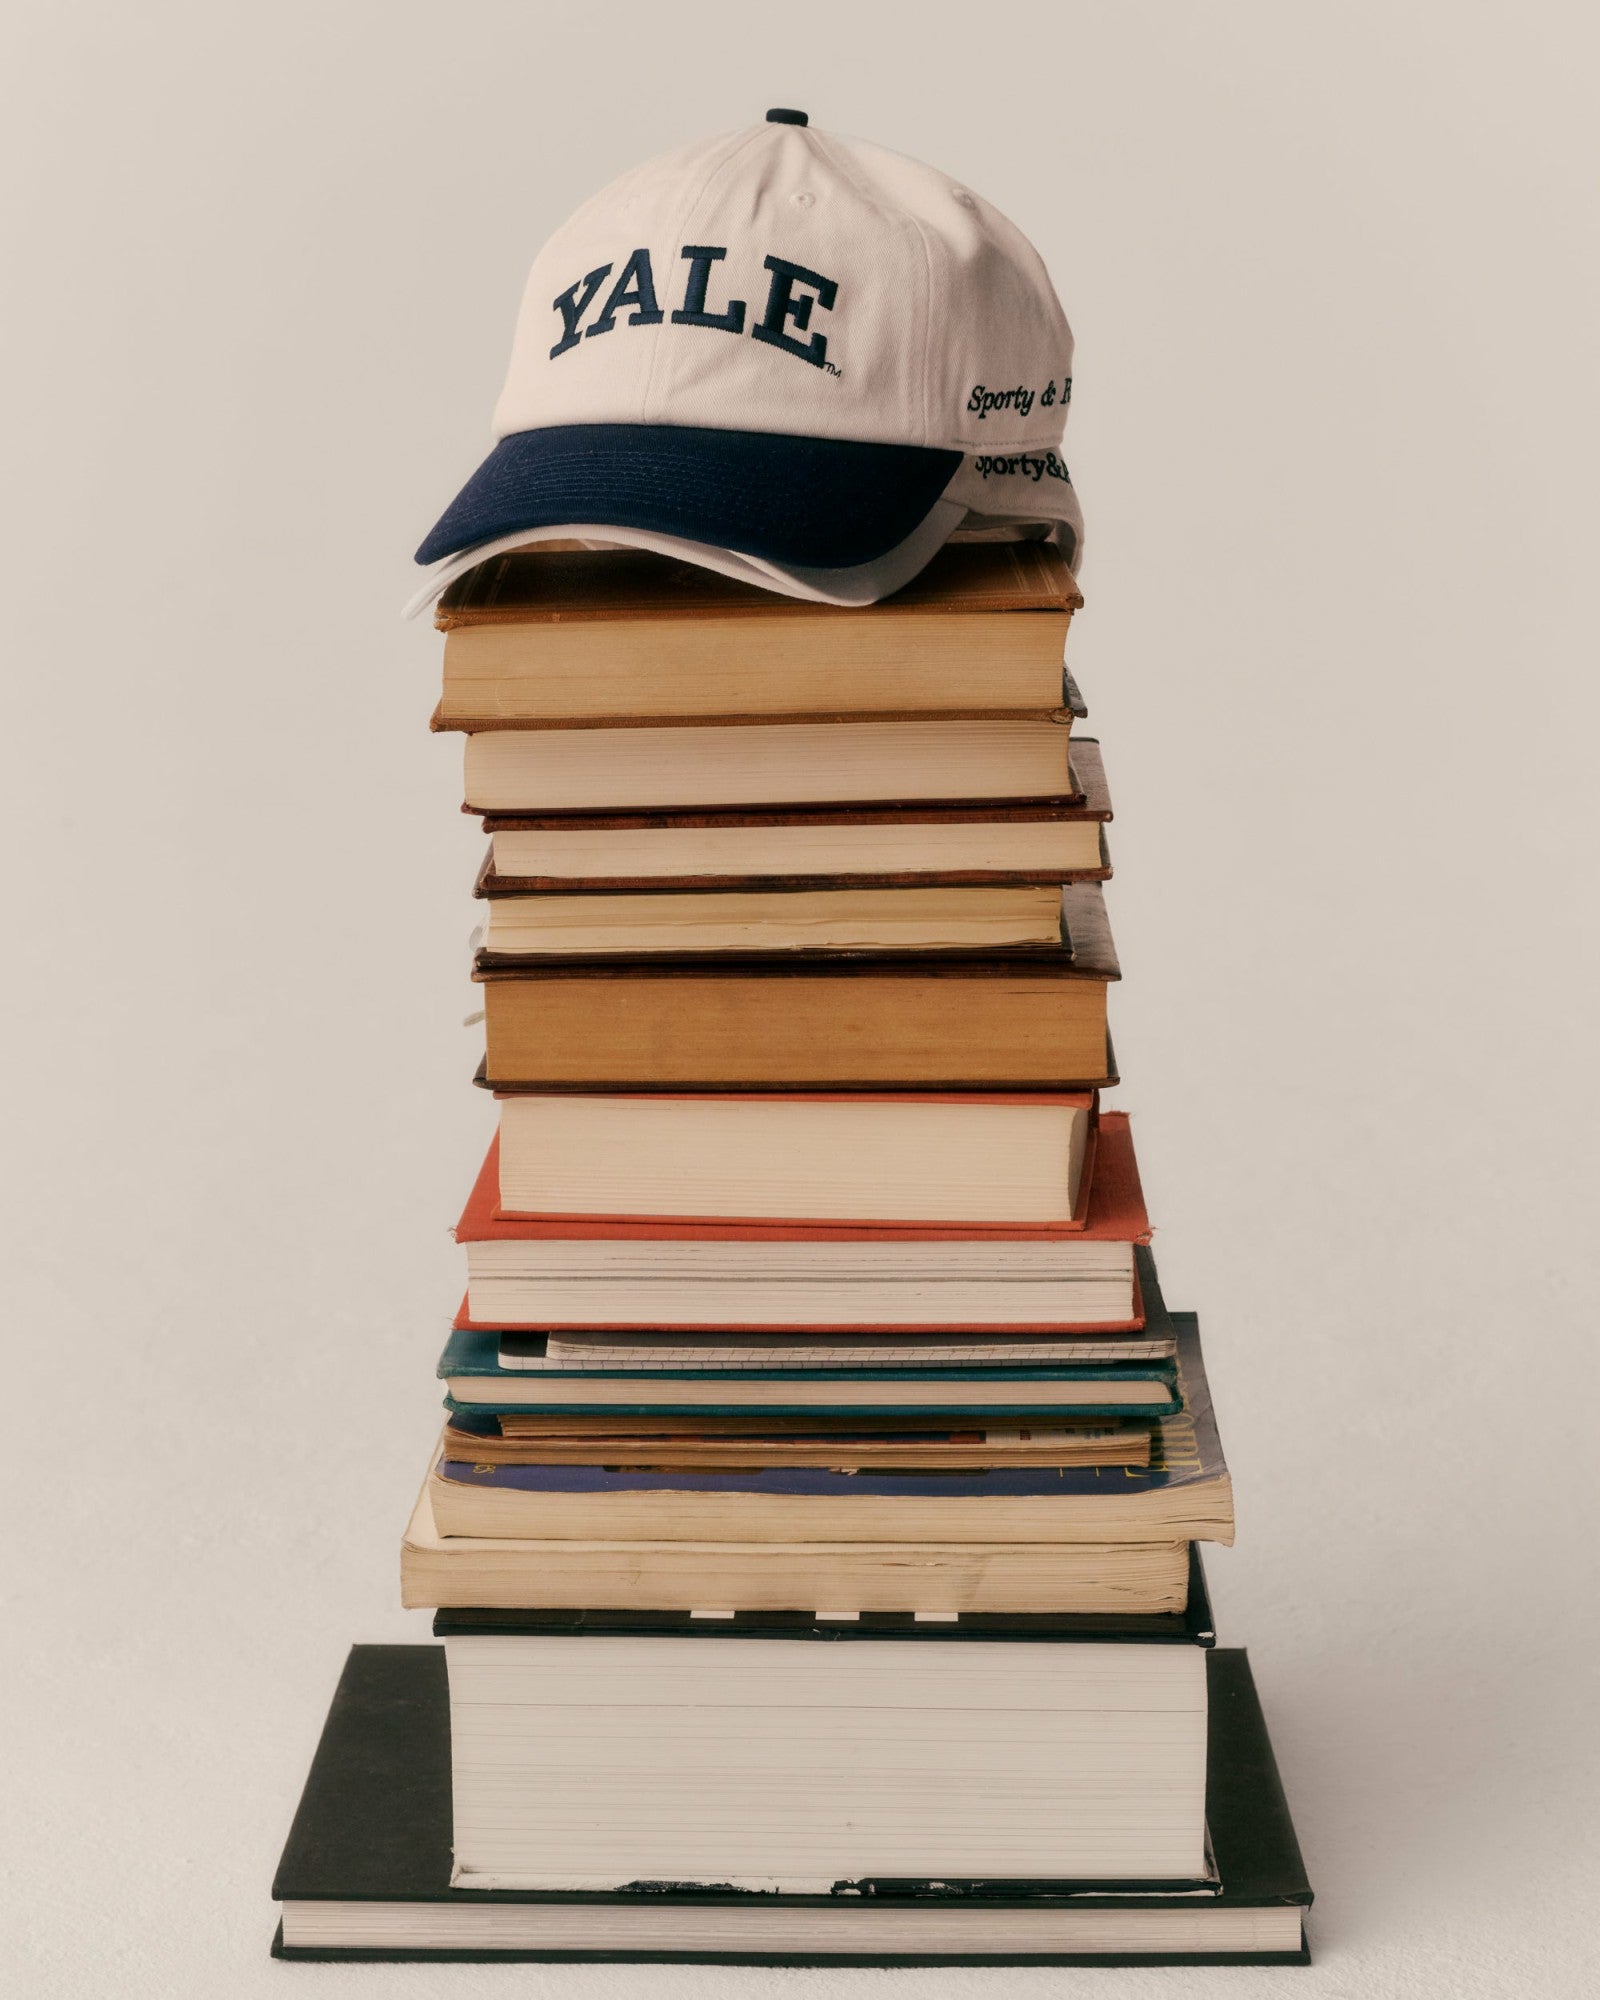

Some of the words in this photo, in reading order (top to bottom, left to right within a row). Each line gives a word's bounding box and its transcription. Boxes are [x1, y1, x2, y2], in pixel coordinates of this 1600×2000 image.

[549, 245, 839, 369] YALE
[967, 385, 1035, 419] Sporty
[1040, 380, 1057, 407] &
